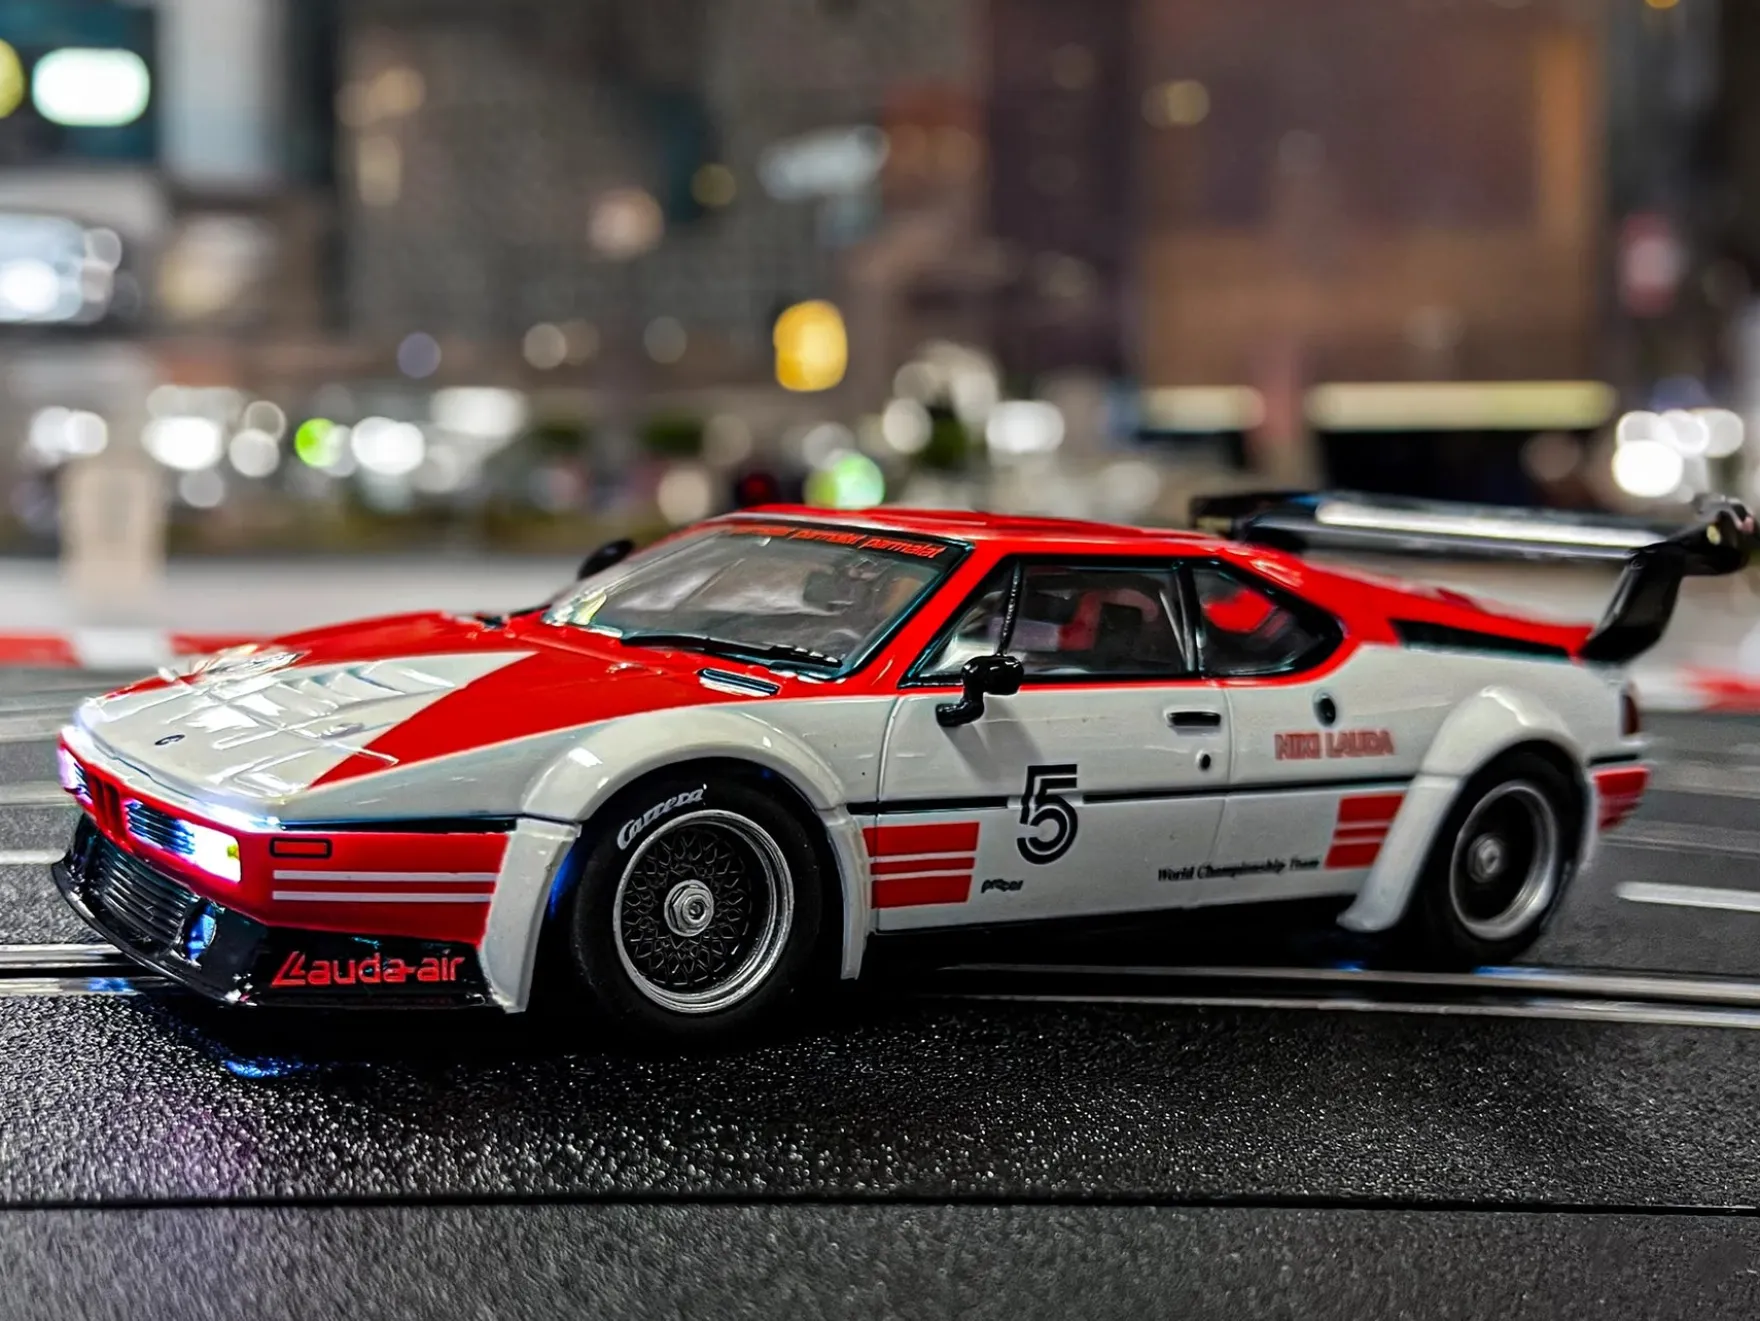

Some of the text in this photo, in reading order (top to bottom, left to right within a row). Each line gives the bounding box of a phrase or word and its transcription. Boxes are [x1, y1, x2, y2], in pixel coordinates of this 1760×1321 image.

[1325, 730, 1394, 758] LAUDA
[617, 788, 704, 850] Carrera
[1017, 764, 1078, 865] 5
[271, 949, 466, 987] Lauda-air
